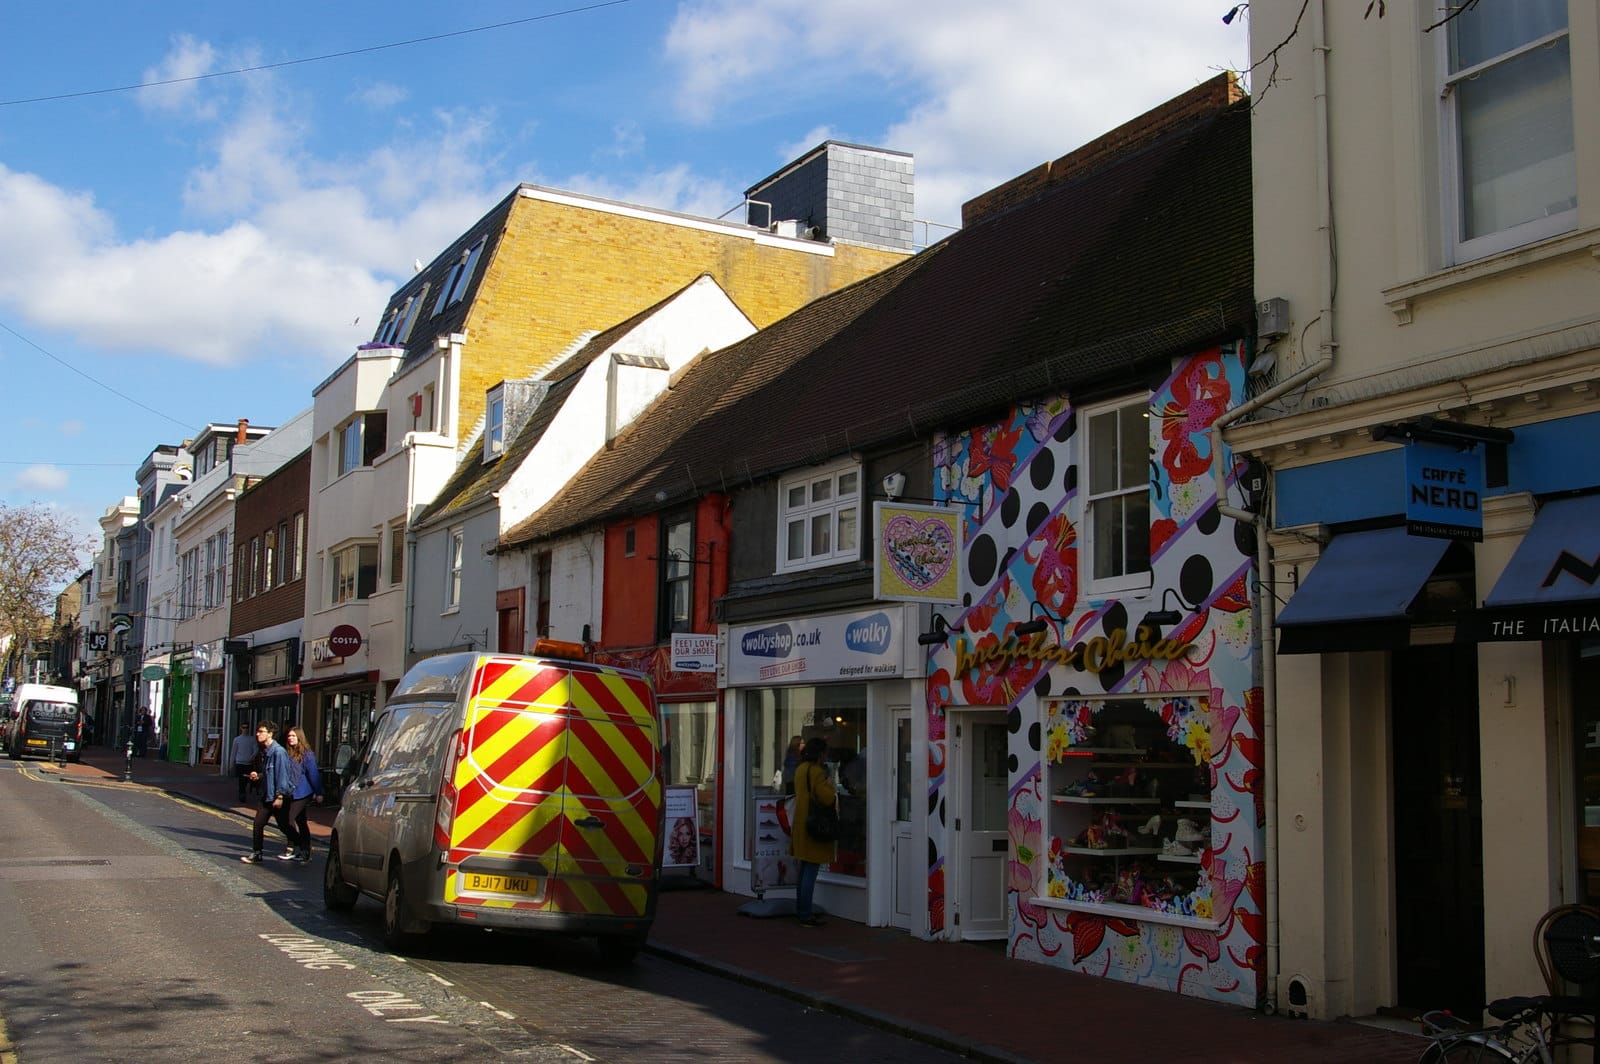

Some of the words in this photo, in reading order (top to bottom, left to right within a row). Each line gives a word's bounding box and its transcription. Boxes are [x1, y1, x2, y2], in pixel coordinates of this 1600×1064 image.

[1263, 303, 1271, 312] 3
[1254, 480, 1260, 489] 3
[1422, 467, 1465, 484] CAFFÈ
[1412, 485, 1478, 510] NERO
[852, 623, 888, 647] wolky
[1492, 620, 1525, 635] THE
[1543, 617, 1600, 634] ITALIA
[745, 628, 821, 654] wolkyshop.co.uk
[953, 631, 1078, 680] Irregular
[1083, 624, 1198, 673] Choice
[840, 664, 864, 677] designed
[864, 663, 874, 674] for
[874, 663, 897, 675] walking
[32, 702, 77, 715] AUTO
[473, 876, 500, 889] BJ17
[504, 879, 529, 892] UKU
[258, 934, 356, 969] LOADING
[346, 990, 448, 1023] ONLY
